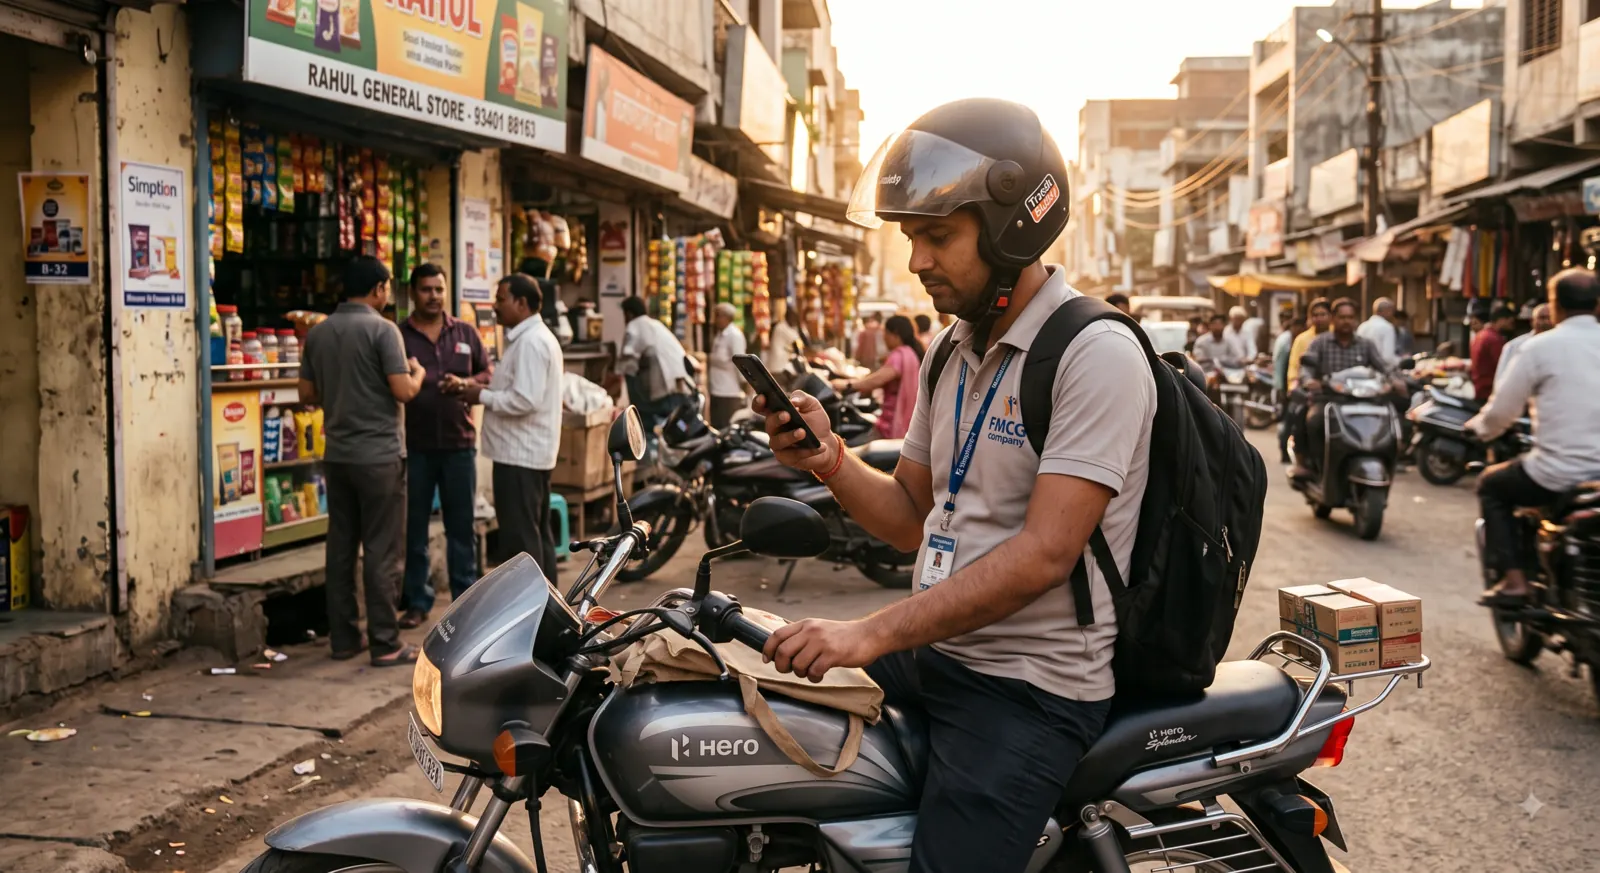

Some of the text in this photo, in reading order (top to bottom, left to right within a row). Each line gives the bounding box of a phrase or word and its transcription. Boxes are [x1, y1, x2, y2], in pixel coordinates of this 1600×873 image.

[386, 0, 481, 35] HUL
[308, 63, 358, 97] RAHUL
[363, 77, 423, 112] GENERAL
[427, 94, 465, 122] STORE
[474, 106, 504, 131] 93401
[507, 115, 536, 138] 88163
[128, 175, 177, 199] Simption
[41, 263, 68, 275] B-32
[988, 416, 1027, 438] FMCG
[987, 432, 1025, 449] company
[1160, 727, 1184, 737] Hero
[699, 739, 759, 756] Hero
